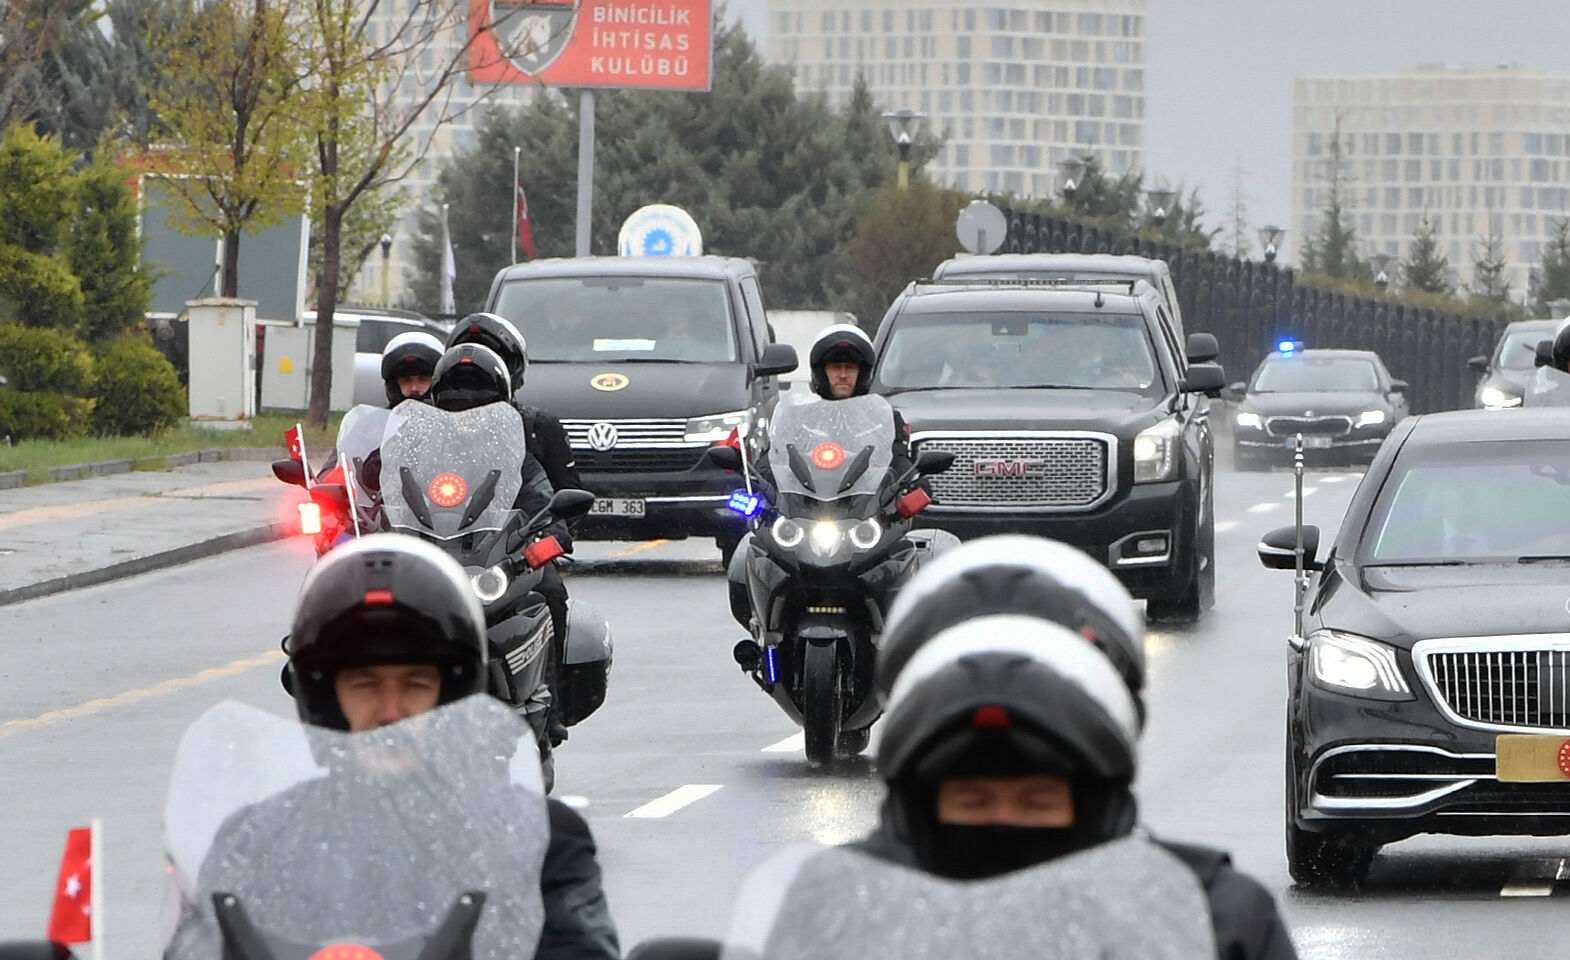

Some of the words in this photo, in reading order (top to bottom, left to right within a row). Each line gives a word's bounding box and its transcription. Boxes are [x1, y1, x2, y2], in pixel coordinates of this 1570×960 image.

[593, 3, 689, 25] BİNİCİLİK
[592, 27, 689, 50] İHTİSAS
[591, 54, 688, 75] KULÜBÜ
[974, 460, 1044, 476] GMC
[622, 500, 644, 514] 363
